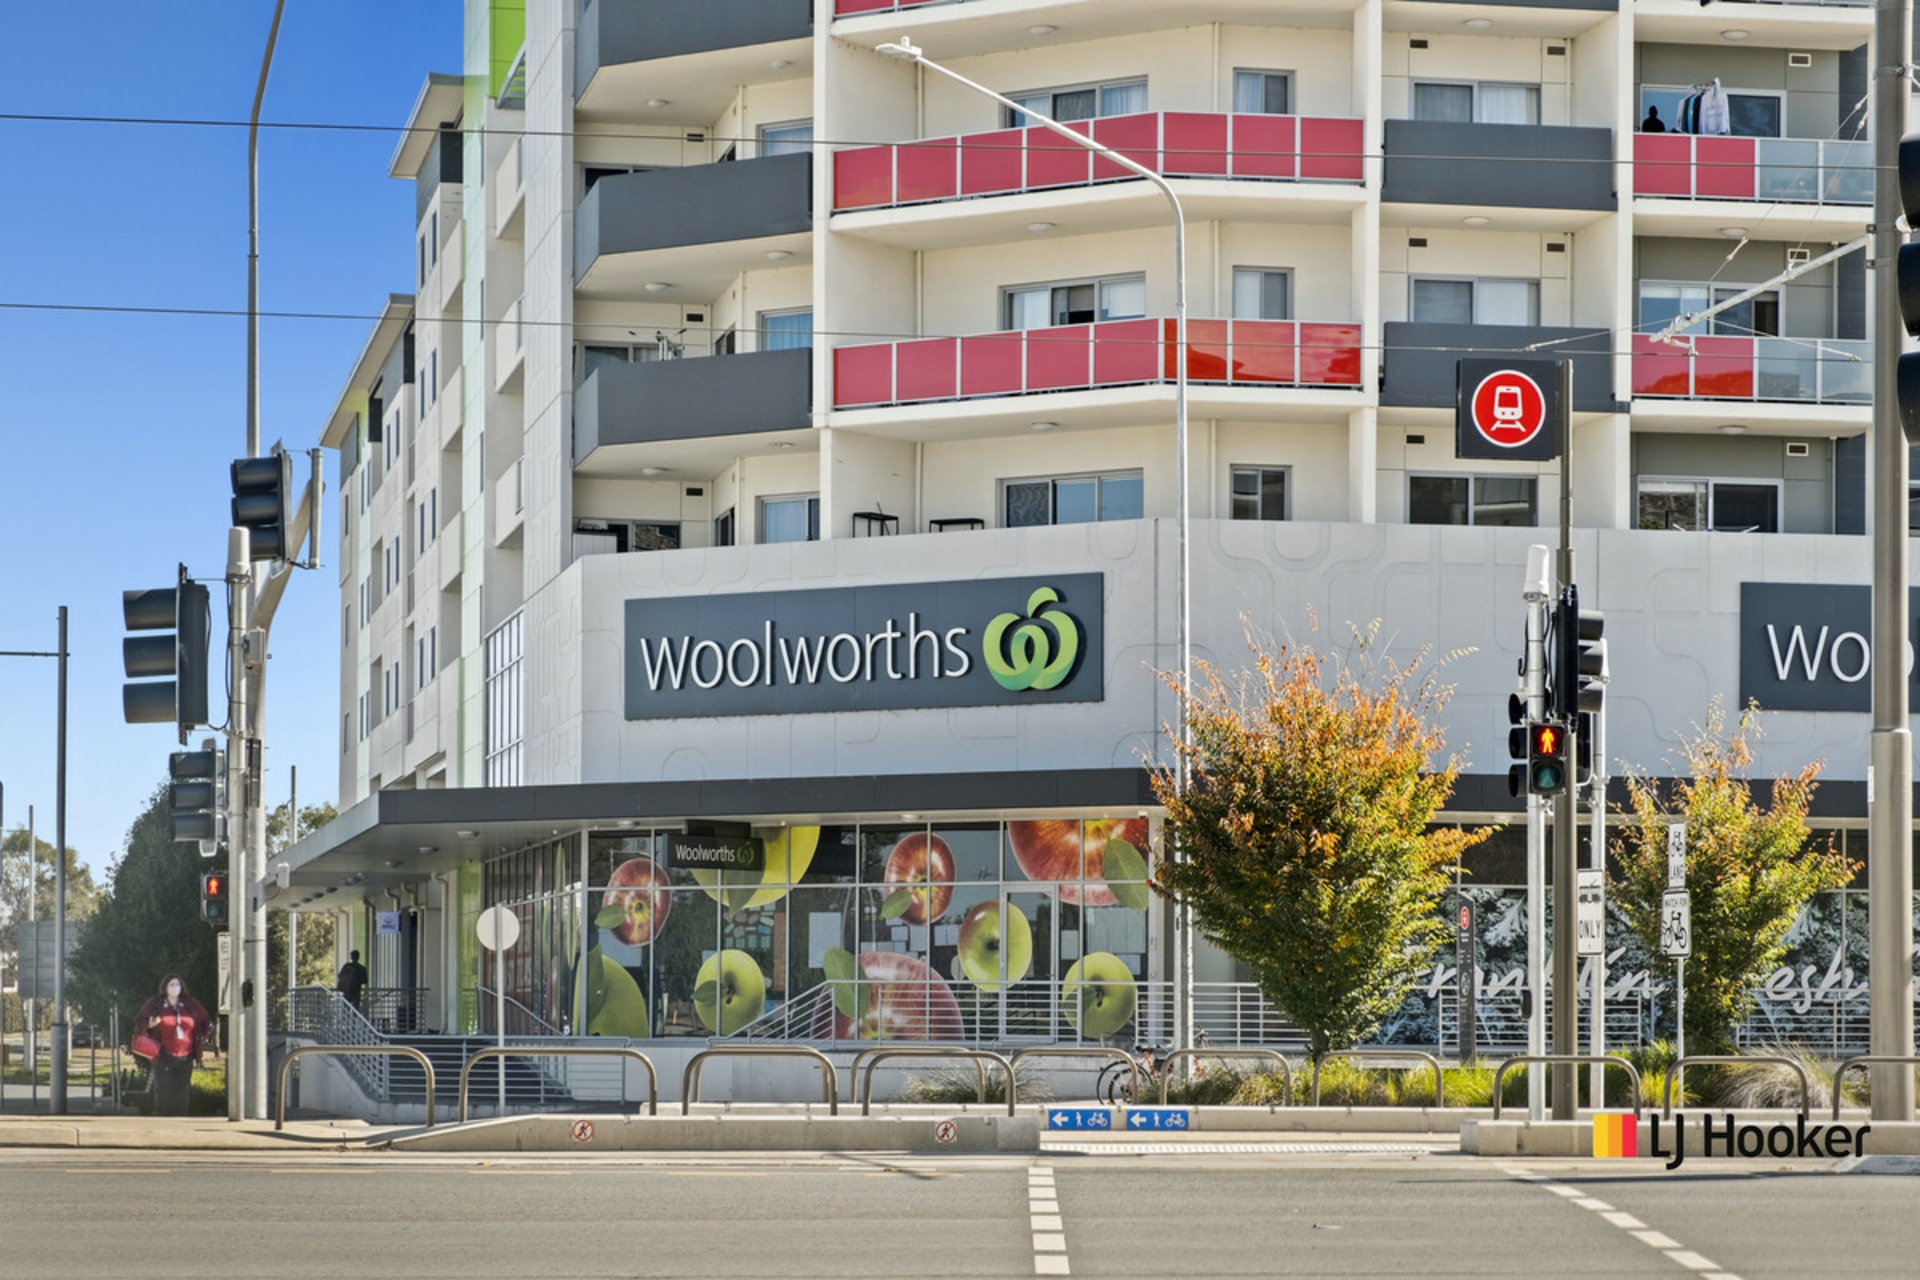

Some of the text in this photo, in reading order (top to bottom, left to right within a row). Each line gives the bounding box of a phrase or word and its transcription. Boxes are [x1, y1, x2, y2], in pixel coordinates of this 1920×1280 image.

[639, 611, 973, 692] Woolworths
[1767, 624, 1915, 683] Wo
[674, 844, 736, 863] Woolworths
[1578, 919, 1602, 939] ONLY
